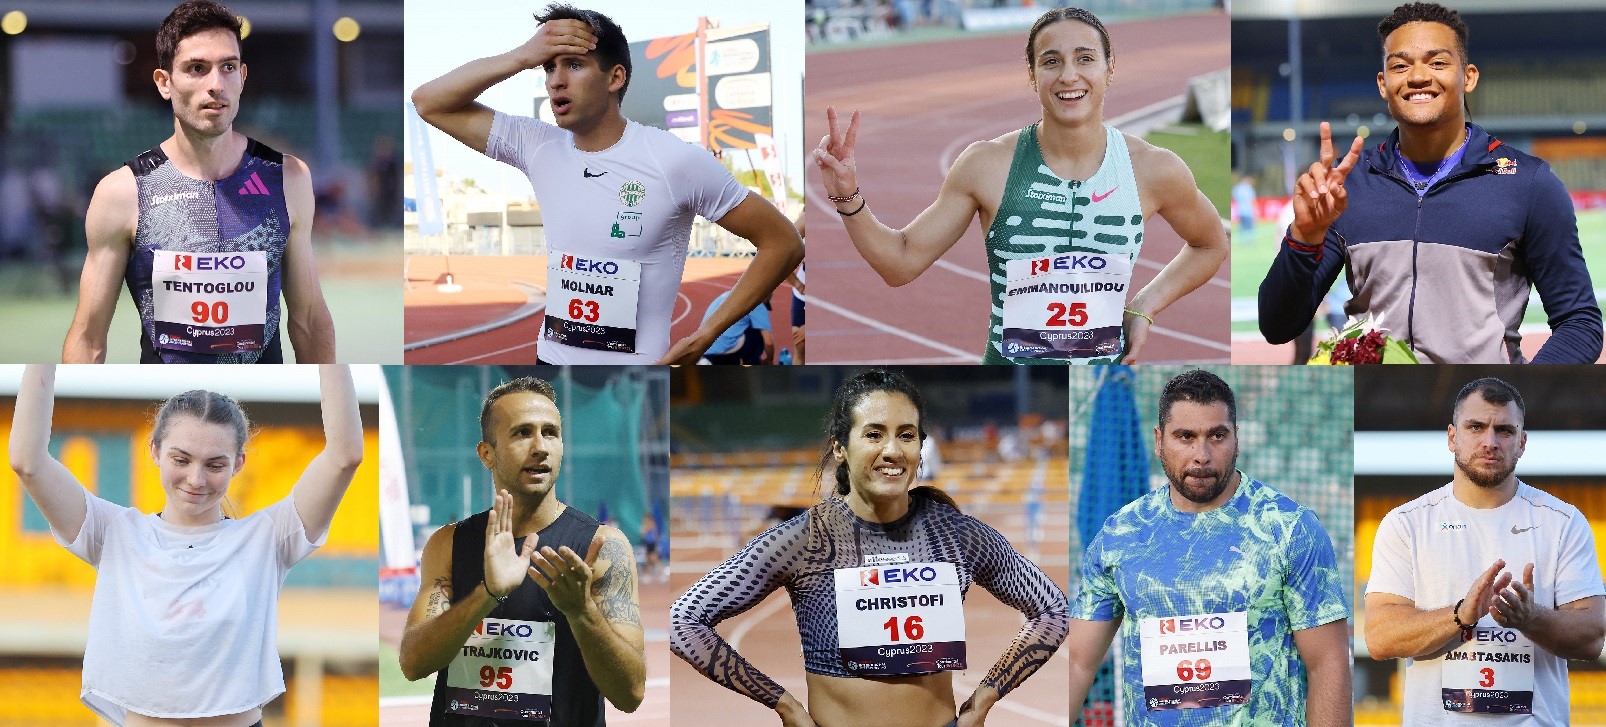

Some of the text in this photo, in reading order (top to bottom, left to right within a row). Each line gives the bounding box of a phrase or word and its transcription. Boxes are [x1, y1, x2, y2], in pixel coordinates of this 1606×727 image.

[197, 256, 246, 270] EKO
[575, 258, 619, 275] EKO
[1053, 256, 1107, 270] EKO
[163, 281, 255, 293] TENTOGLOU
[561, 279, 614, 296] MOLNAR
[1007, 282, 1125, 297] EMMANOUILIDOU
[191, 301, 229, 324] 90
[568, 298, 600, 323] 63
[1045, 302, 1089, 327] 25
[186, 326, 235, 338] Cyprus2023
[1039, 330, 1094, 342] Cyprus2023
[883, 566, 937, 583] EKO
[855, 594, 944, 611] CHRISTOFI
[486, 622, 533, 638] EKO
[883, 615, 925, 642] 16
[1179, 616, 1225, 632] EKO
[1476, 630, 1517, 643] EKO
[463, 645, 540, 662] TRAJKOVIC
[877, 644, 933, 658] Cyprus2023
[1159, 640, 1228, 656] PARELLIS
[479, 664, 513, 690] 95
[1176, 658, 1212, 681] 69
[1479, 667, 1495, 688] 3
